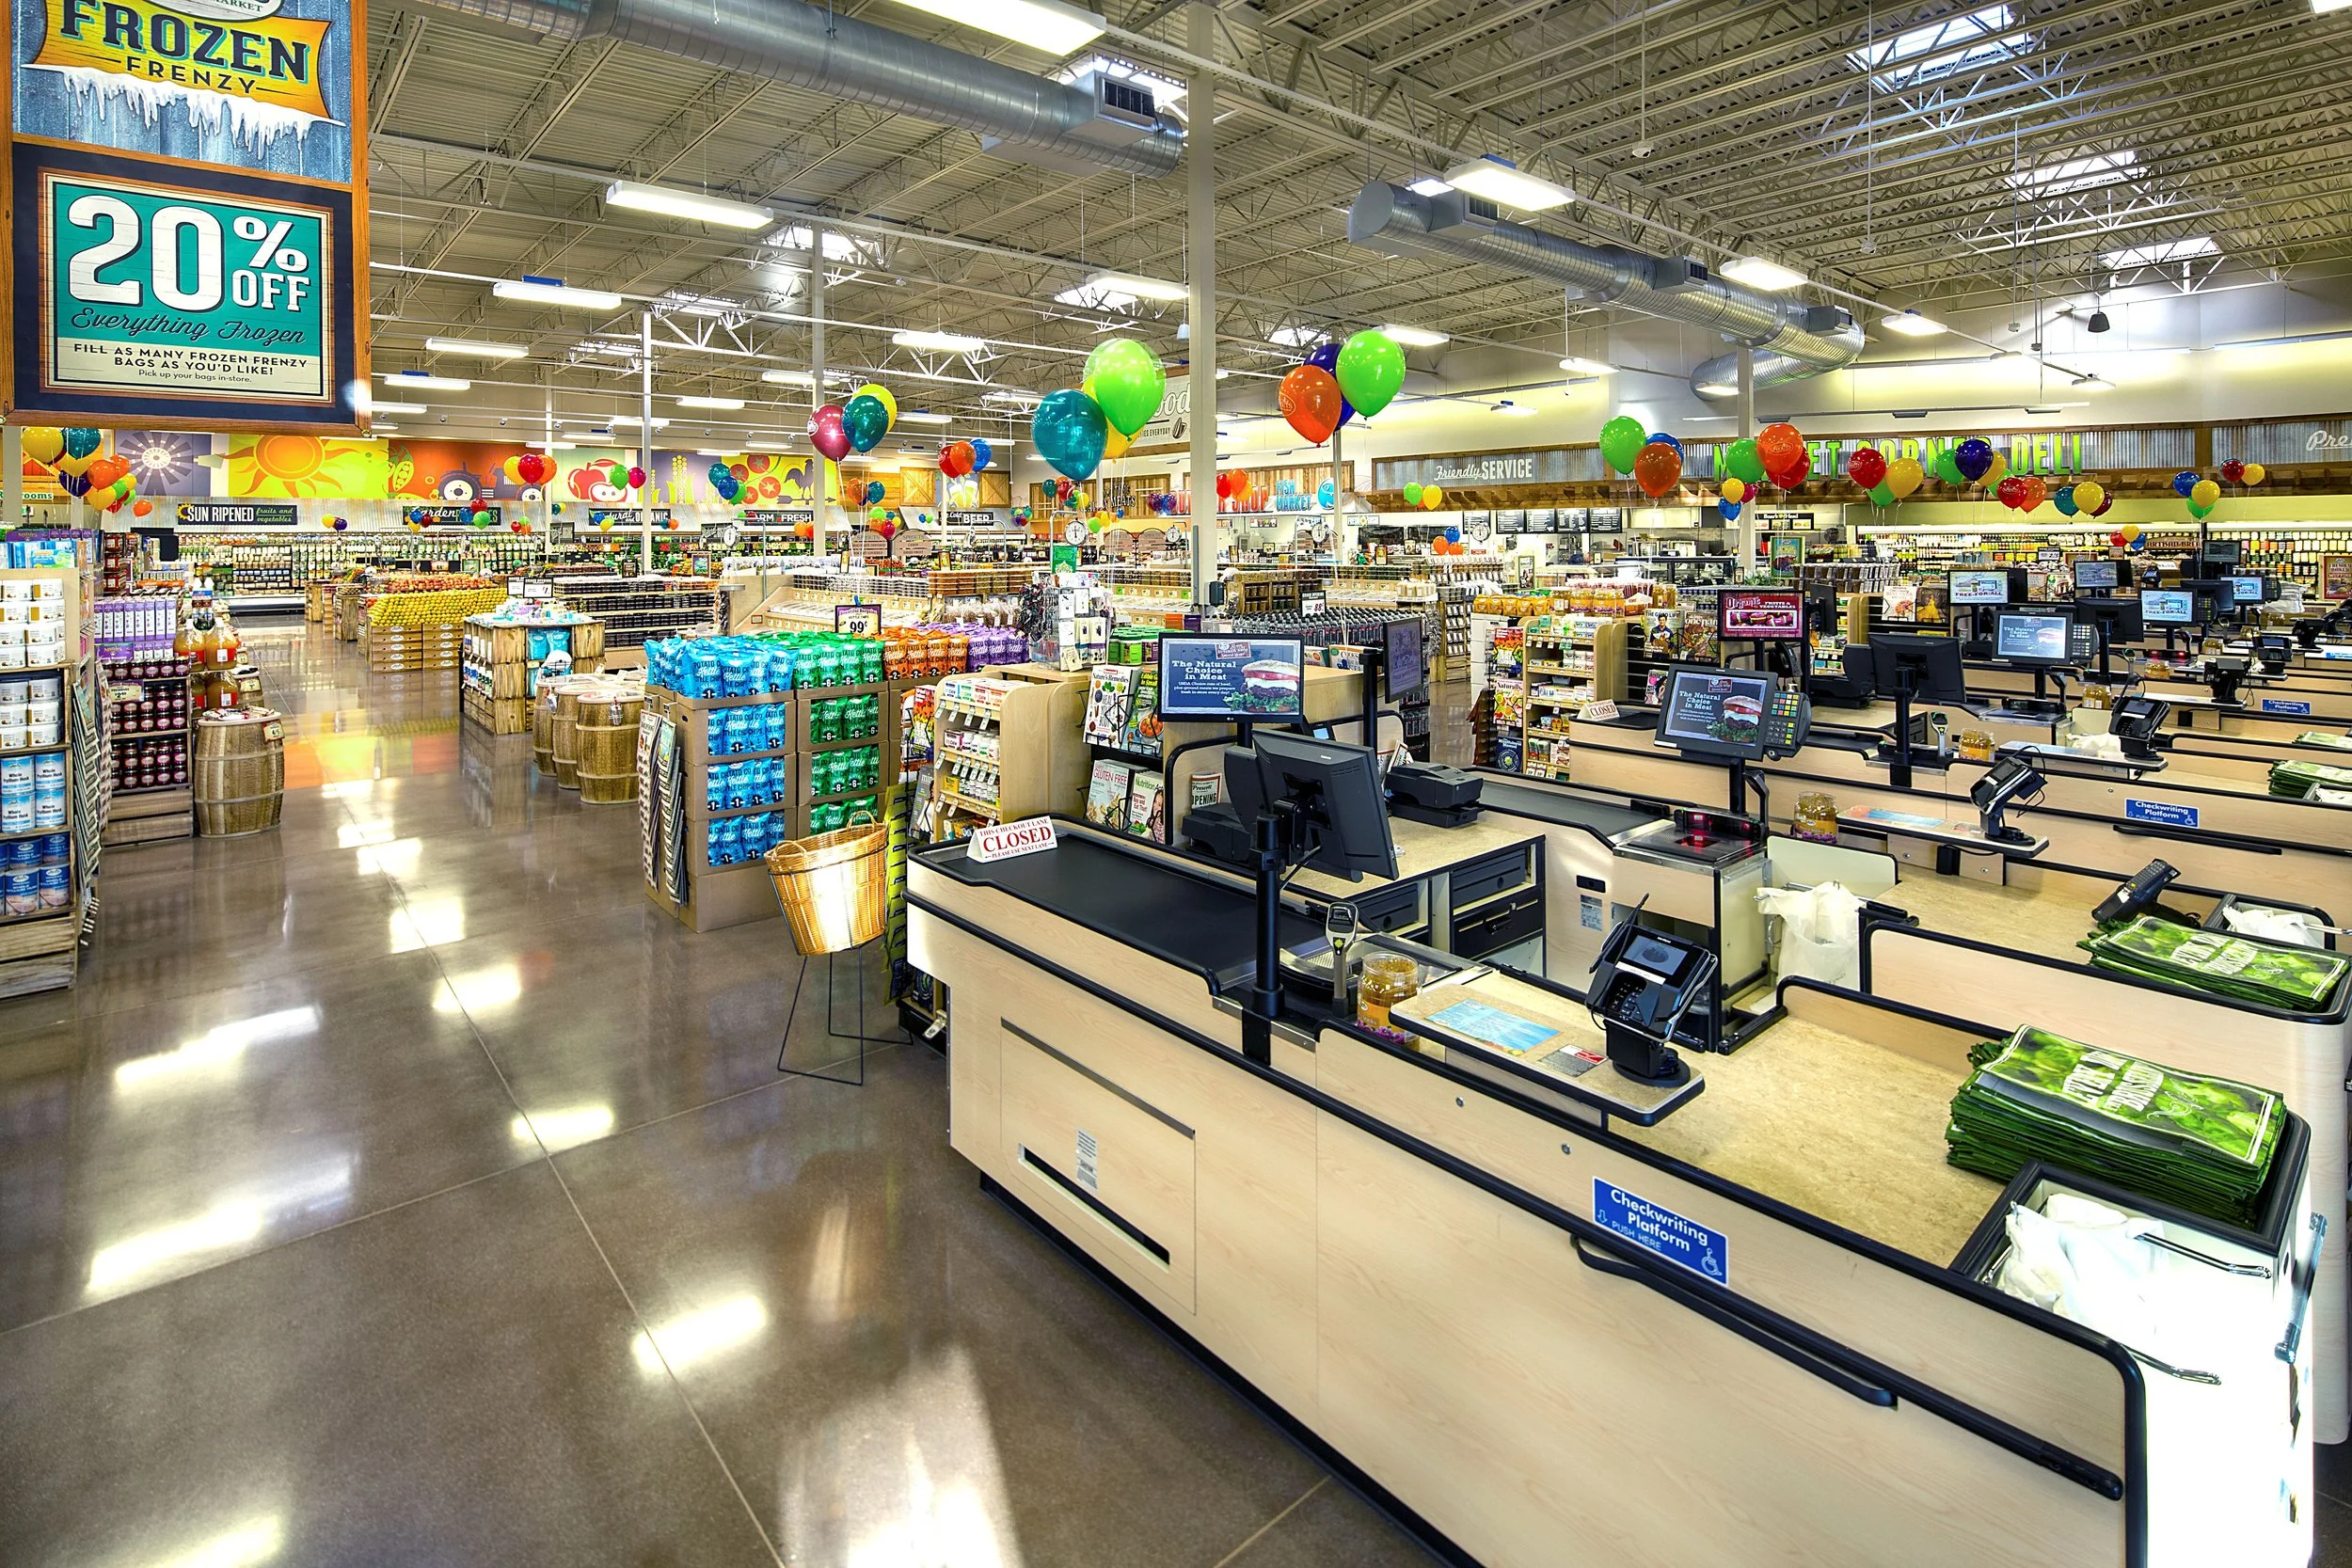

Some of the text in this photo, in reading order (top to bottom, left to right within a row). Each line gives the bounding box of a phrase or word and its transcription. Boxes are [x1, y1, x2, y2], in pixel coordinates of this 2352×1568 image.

[213, 0, 262, 11] ARKET
[60, 0, 310, 84] FROZEN
[127, 56, 257, 93] FRENZY
[232, 269, 310, 311] OFF
[72, 307, 307, 345] Everything Frozen
[74, 343, 308, 368] FILL AS MANY FROZEN FRENZY
[114, 357, 274, 375] BAGS AS YOU'D LIKE!
[138, 369, 252, 384] Pick up your bags in-store.
[1150, 427, 1170, 436] EVERYDAY
[2010, 434, 2082, 476] DELI
[1434, 458, 1532, 481] Friendly SERVICE
[1277, 480, 1295, 495] FISH
[1277, 495, 1312, 511] MARKET
[187, 507, 254, 522] SUN RIPENED
[635, 512, 669, 522] ORANIC
[781, 514, 812, 522] FRESH
[850, 621, 867, 633] 99¢
[693, 659, 714, 668] POTATO
[696, 667, 720, 676] Kettle
[723, 673, 746, 681] Kettle
[1686, 697, 1710, 705] Choice
[1693, 692, 1721, 701] Natural
[1590, 705, 1616, 717] CLOSED
[1093, 768, 1127, 785] GLUTEN FREE
[2136, 801, 2189, 815] Checkwriting
[2144, 809, 2180, 819] Platform
[979, 818, 1049, 837] THIS CHECKOUT LANE
[982, 826, 1052, 852] CLOSED
[992, 850, 1010, 859] PLEASE
[1611, 1189, 1708, 1246] Checkwriting
[1612, 1221, 1661, 1251] PUSH HERE
[1628, 1212, 1691, 1252] Platform
